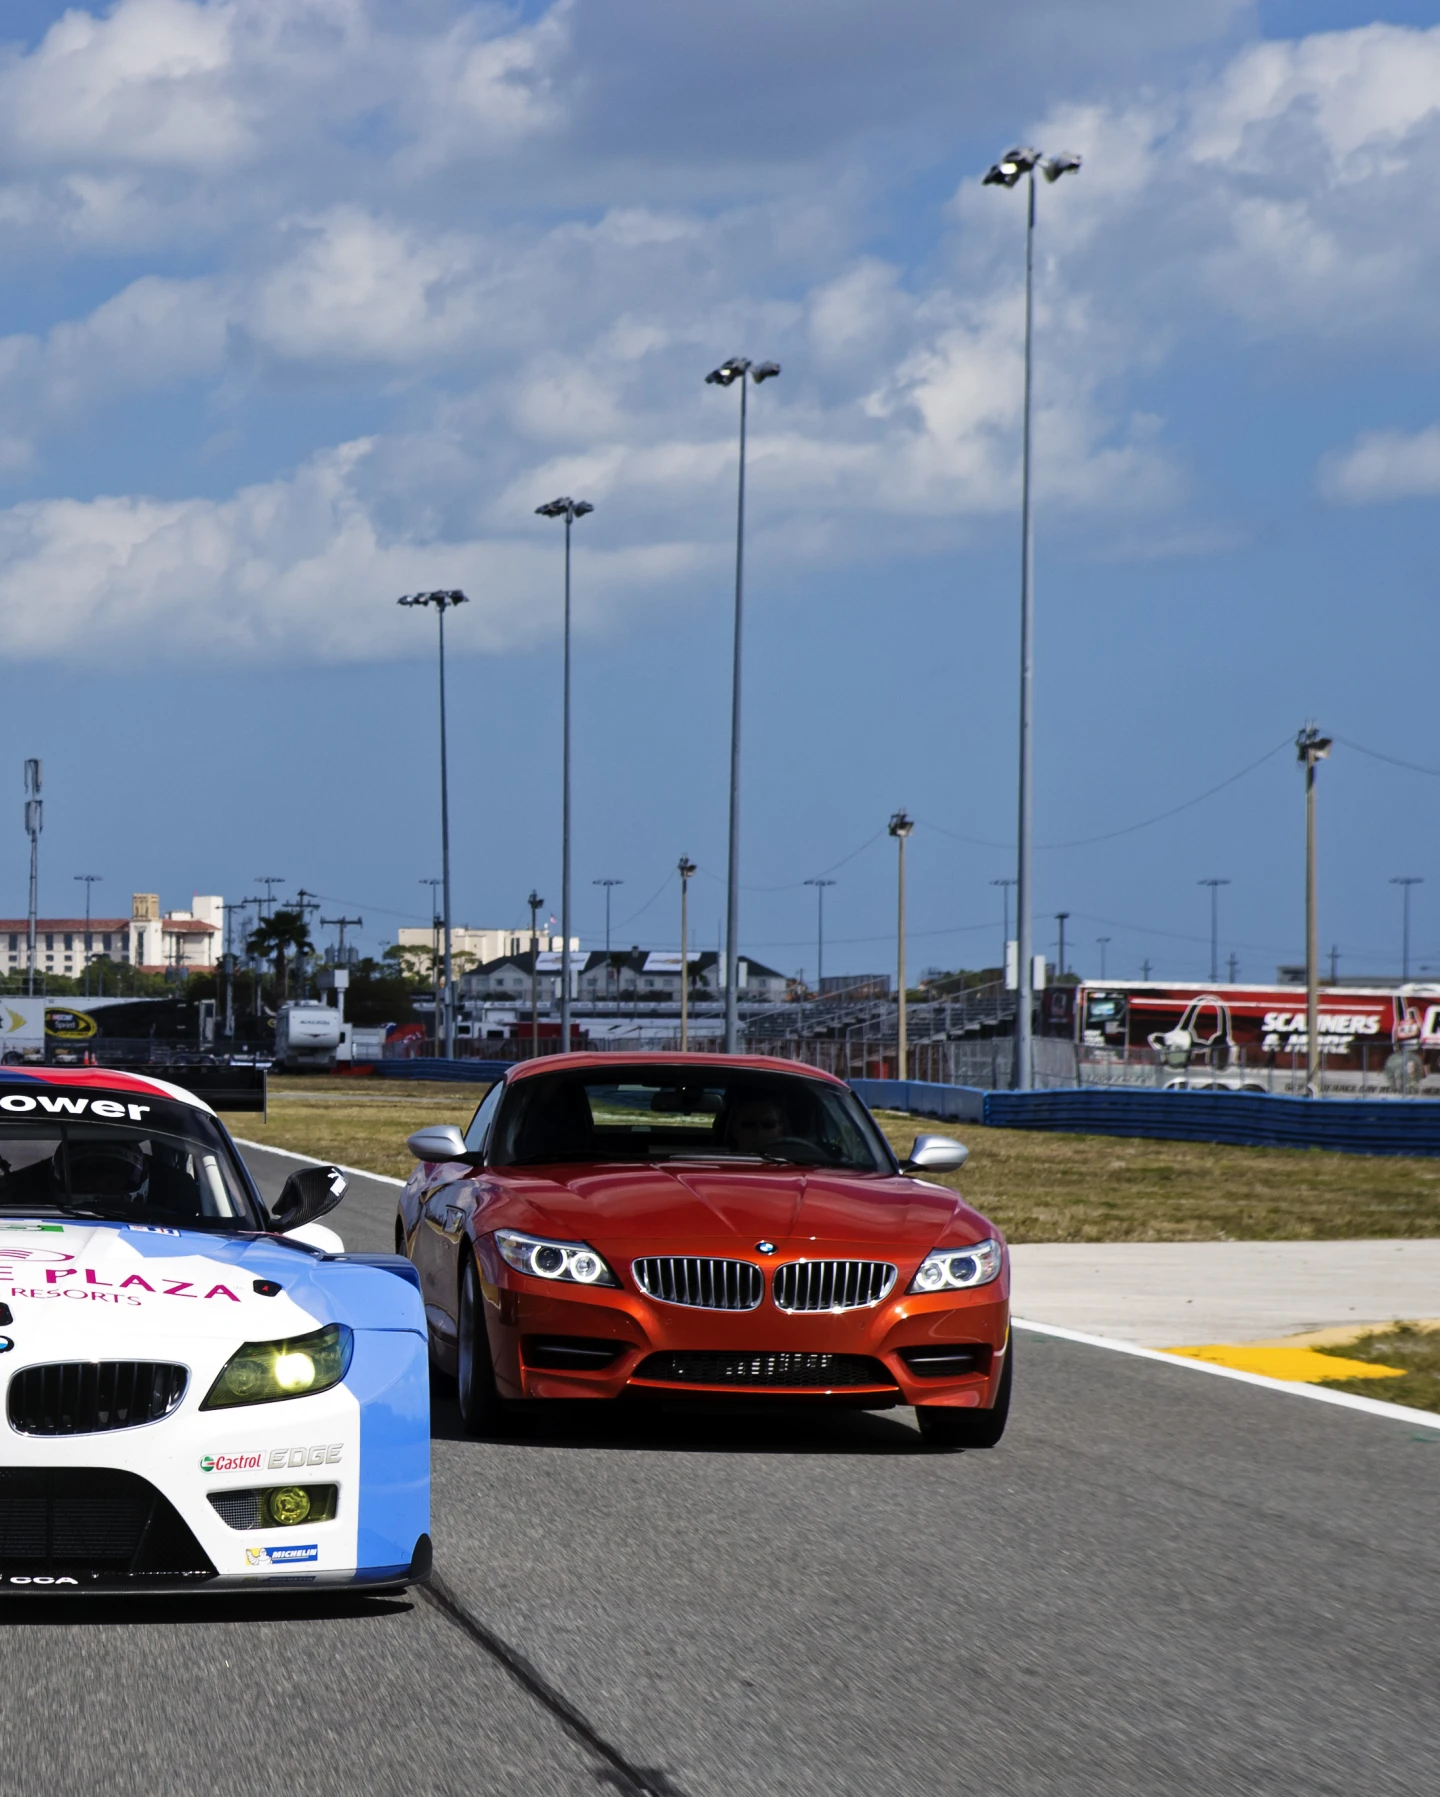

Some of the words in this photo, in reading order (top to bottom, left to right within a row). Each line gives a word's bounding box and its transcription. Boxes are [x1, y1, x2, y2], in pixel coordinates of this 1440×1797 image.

[45, 1268, 242, 1302] PLAZA
[11, 1287, 142, 1306] RESORTS
[215, 1453, 261, 1471] Castrol
[267, 1443, 344, 1469] EDGE
[271, 1548, 317, 1559] MICHELIN
[10, 1576, 79, 1585] CCA
